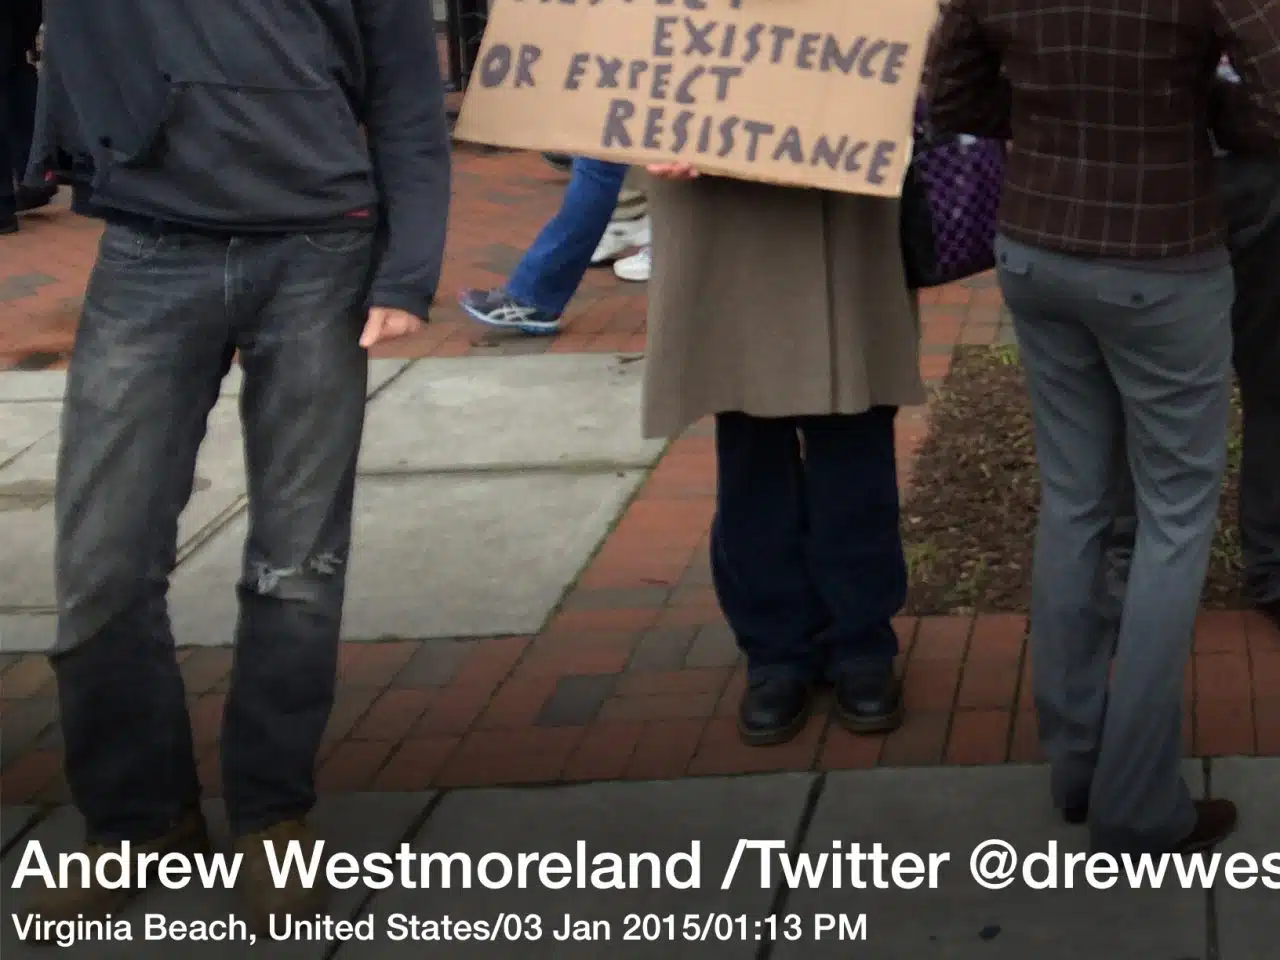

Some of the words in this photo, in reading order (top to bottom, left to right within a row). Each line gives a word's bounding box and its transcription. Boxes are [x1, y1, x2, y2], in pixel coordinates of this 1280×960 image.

[479, 44, 542, 89] OR
[563, 52, 744, 104] EXPECT
[652, 15, 909, 86] EXISTENCE
[602, 99, 896, 186] RESISTANCE
